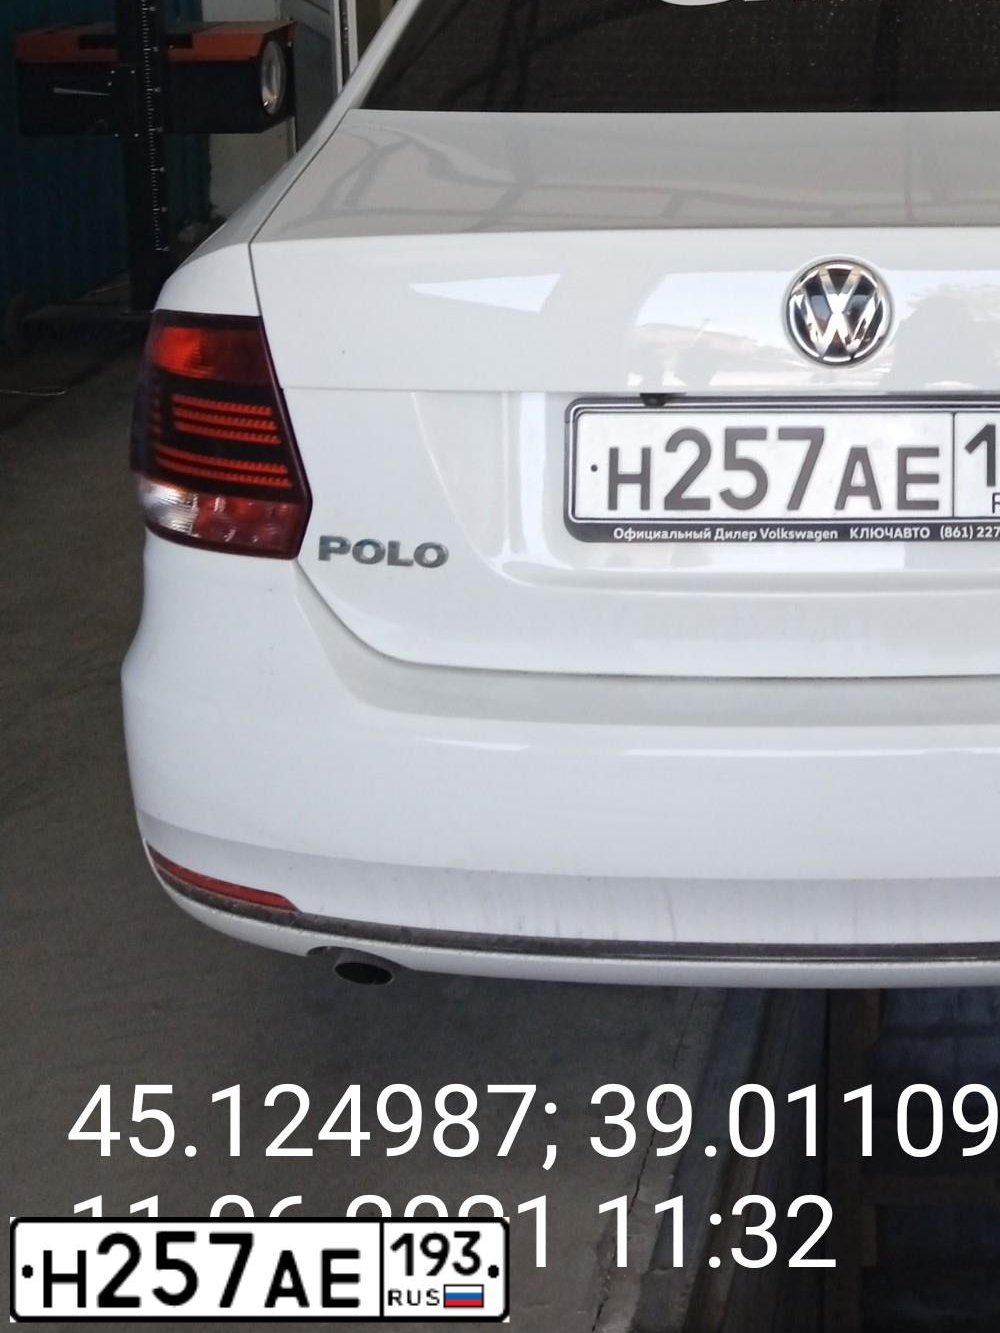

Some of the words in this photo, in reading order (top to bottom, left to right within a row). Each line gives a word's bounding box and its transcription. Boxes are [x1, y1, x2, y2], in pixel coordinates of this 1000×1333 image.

[612, 526, 712, 542] Официальный
[713, 527, 757, 542] Дилер
[759, 526, 839, 542] Volkswagen
[849, 526, 931, 540] КЛЮЧАВТО
[939, 524, 974, 540] (861)
[317, 534, 449, 569] POLO
